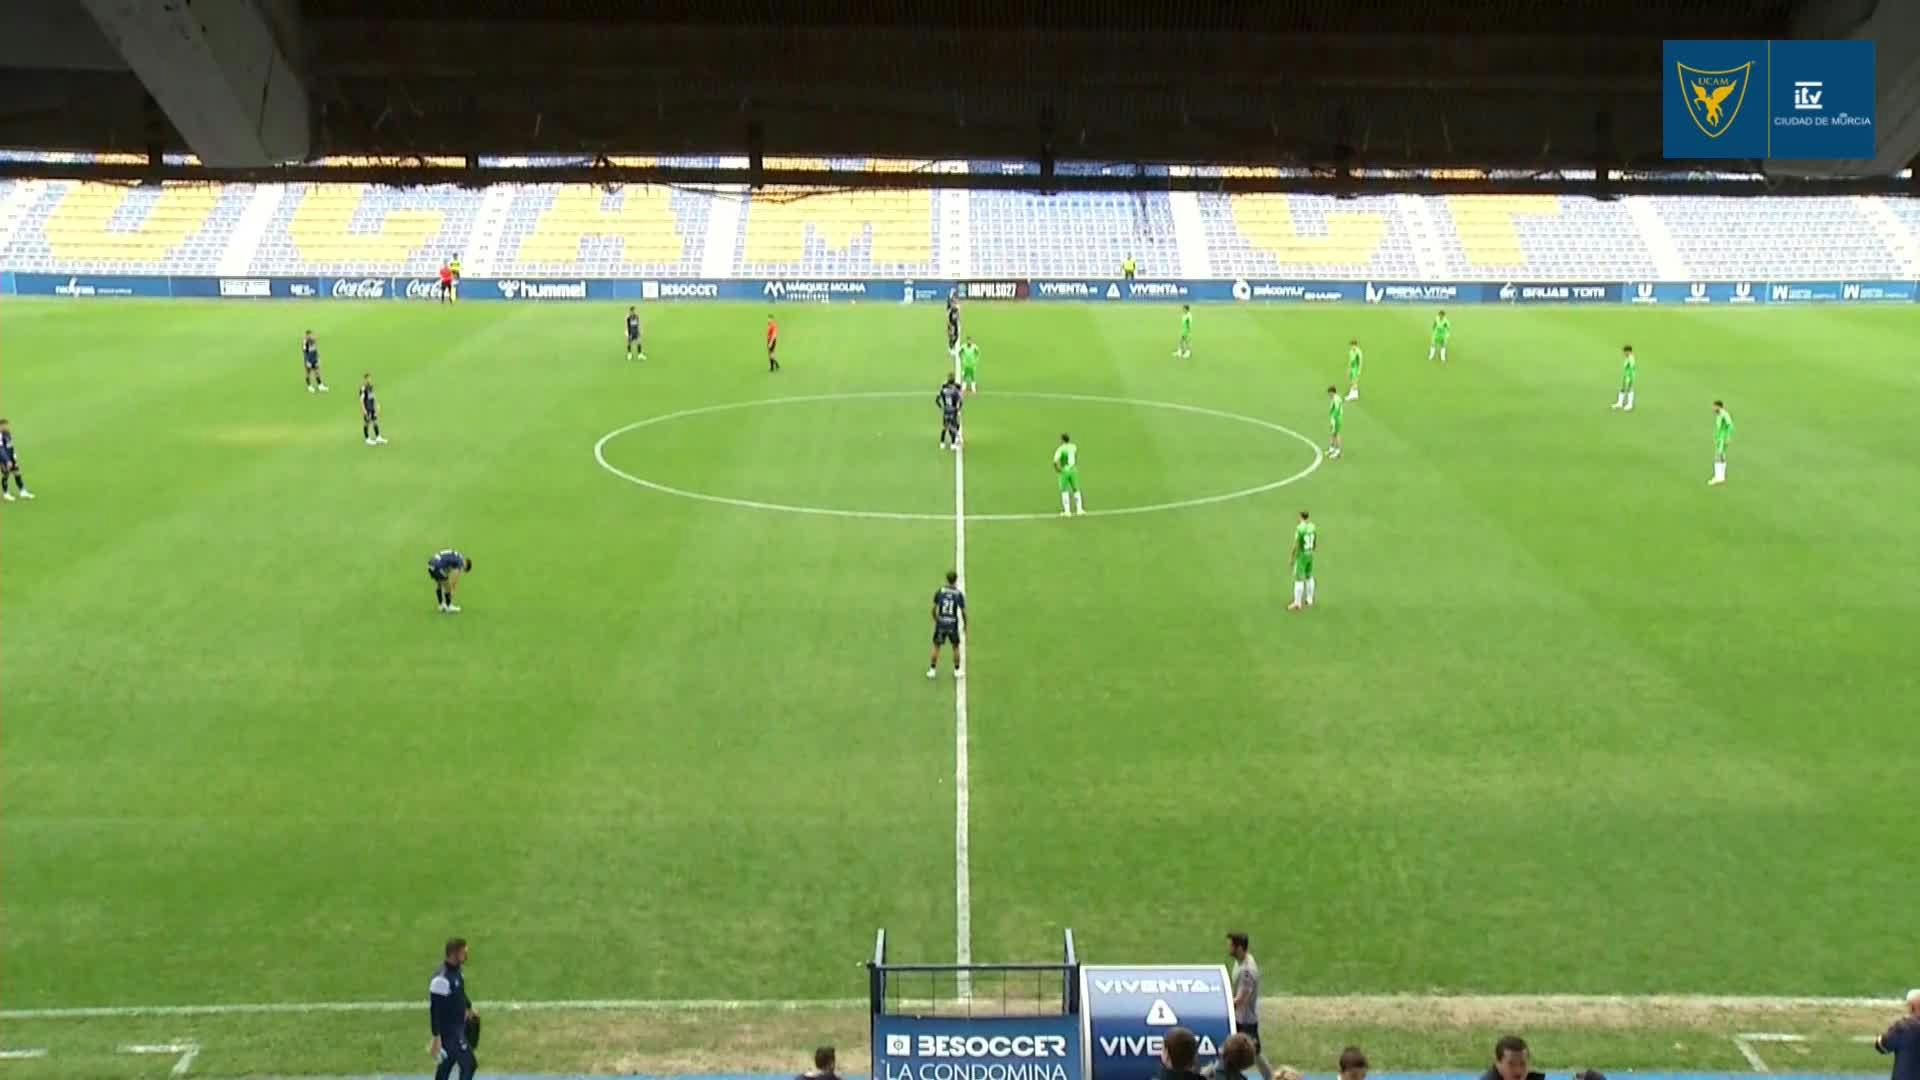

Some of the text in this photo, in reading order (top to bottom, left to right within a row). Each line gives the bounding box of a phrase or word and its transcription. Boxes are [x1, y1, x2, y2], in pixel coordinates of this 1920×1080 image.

[521, 279, 586, 297] hummel
[786, 280, 866, 292] MÁRQUEZ MOLINA
[1039, 283, 1088, 294] VIVENTA
[1129, 283, 1178, 294] VIVENTA
[942, 599, 954, 615] 21
[1095, 979, 1210, 993] VIVENTA
[918, 1035, 1066, 1057] BESOCCER
[1100, 1035, 1217, 1056] VIVEA
[886, 1063, 1067, 1080] LA CONDOMINA
